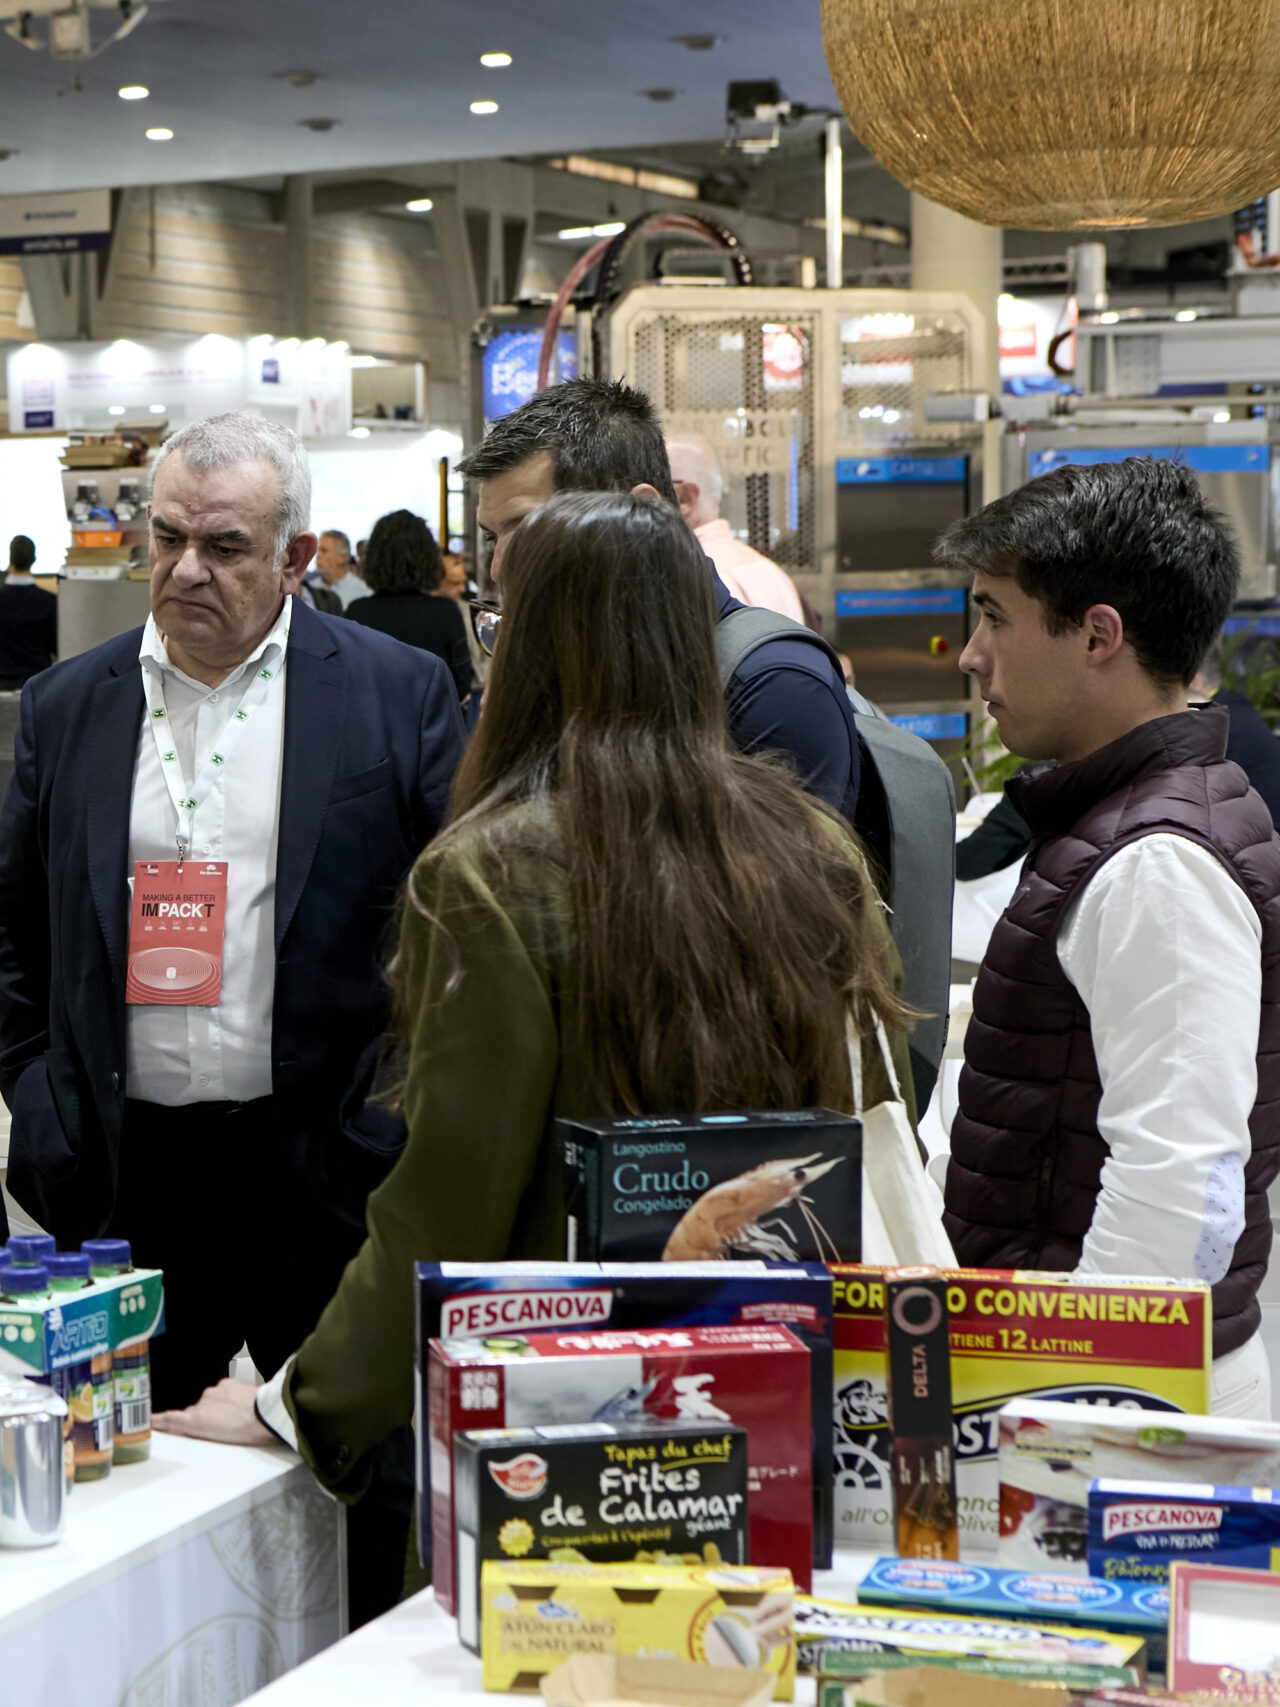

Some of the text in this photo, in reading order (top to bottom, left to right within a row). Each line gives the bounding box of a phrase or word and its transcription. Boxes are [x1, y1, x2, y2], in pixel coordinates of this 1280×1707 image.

[142, 893, 216, 902] MAKING A BETTER
[141, 903, 215, 918] IMPACKT
[613, 1141, 686, 1158] Langostino
[613, 1160, 710, 1194] Crudo
[613, 1195, 693, 1215] Congelado
[447, 1295, 607, 1337] PESCANOVA
[974, 1288, 1190, 1326] CONVENIENZA
[950, 1328, 1093, 1355] TIENE 12 LATTINE
[912, 1343, 929, 1398] DELTA
[604, 1434, 732, 1468] Tapas du chef
[599, 1462, 701, 1496] Frites
[540, 1491, 743, 1527] de Calamar
[842, 1506, 890, 1526] all'O
[1108, 1509, 1218, 1532] PESCANOVA
[685, 1517, 732, 1537] géant
[556, 1621, 616, 1637] CLARO
[528, 1637, 607, 1653] NATURAL
